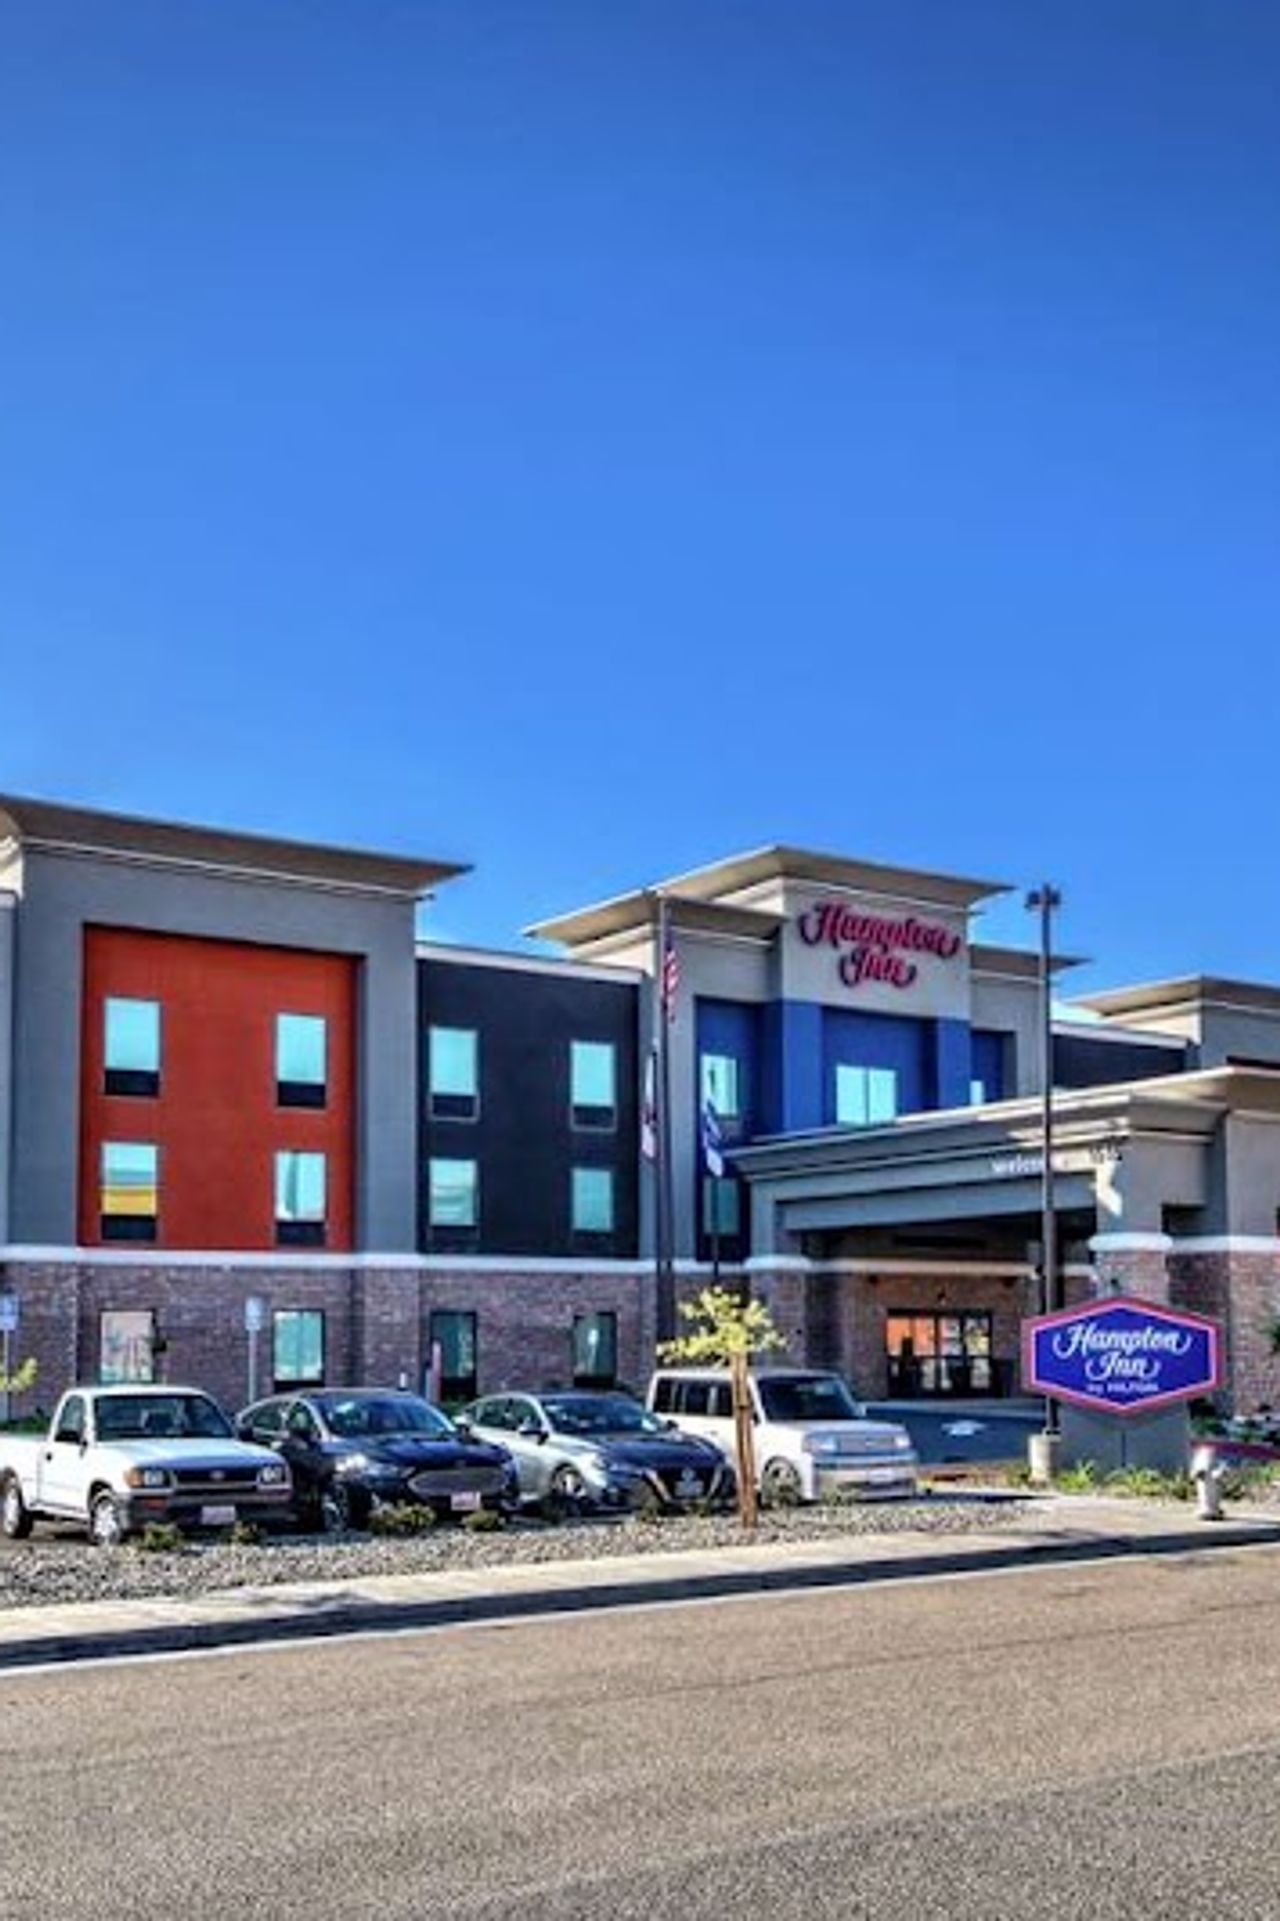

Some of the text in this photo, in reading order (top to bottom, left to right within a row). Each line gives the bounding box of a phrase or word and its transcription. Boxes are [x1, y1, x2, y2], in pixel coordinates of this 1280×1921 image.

[798, 902, 961, 958] Hampton
[839, 948, 917, 988] Inn
[1052, 1321, 1192, 1359] Hampton
[1085, 1351, 1161, 1381] Inn
